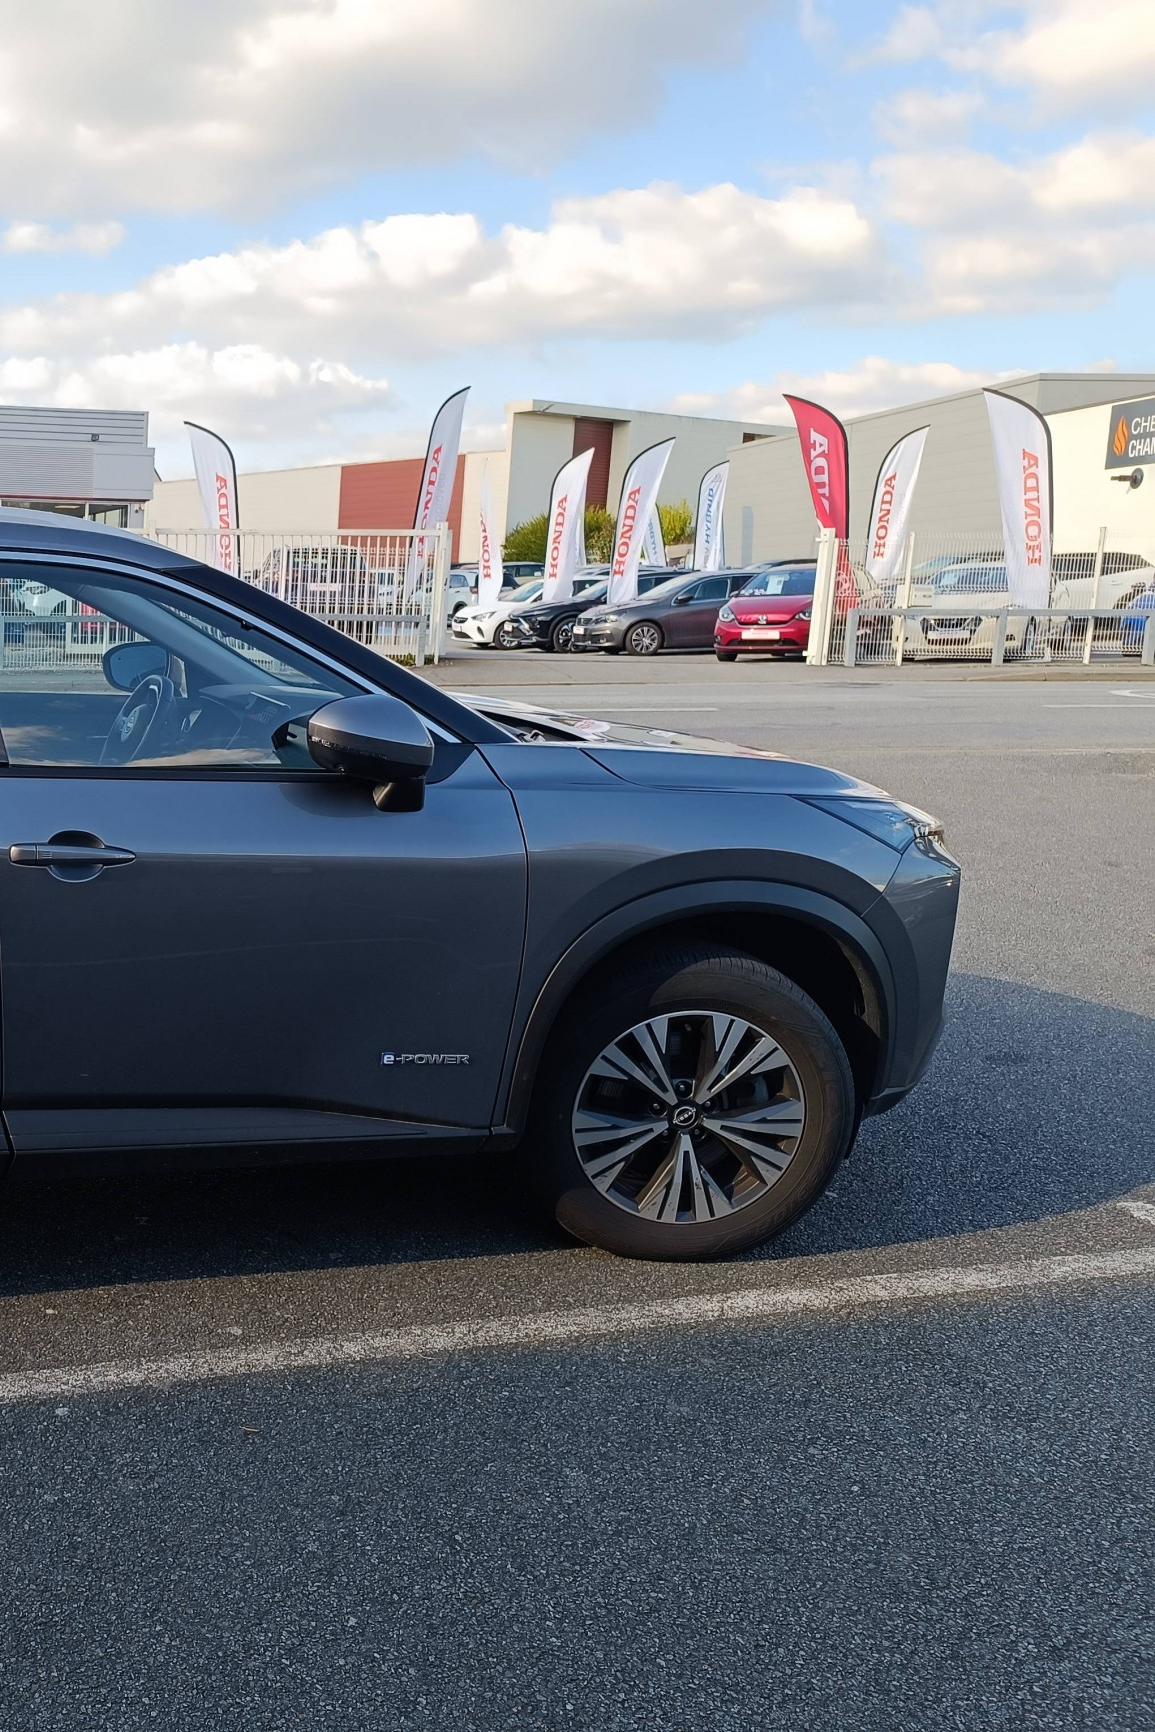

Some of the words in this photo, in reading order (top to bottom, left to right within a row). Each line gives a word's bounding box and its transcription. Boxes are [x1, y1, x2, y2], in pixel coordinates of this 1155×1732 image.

[549, 494, 568, 579] HONDA
[613, 486, 641, 577] HONDA
[873, 472, 898, 559] HONDA
[382, 1053, 470, 1065] e-POWER
